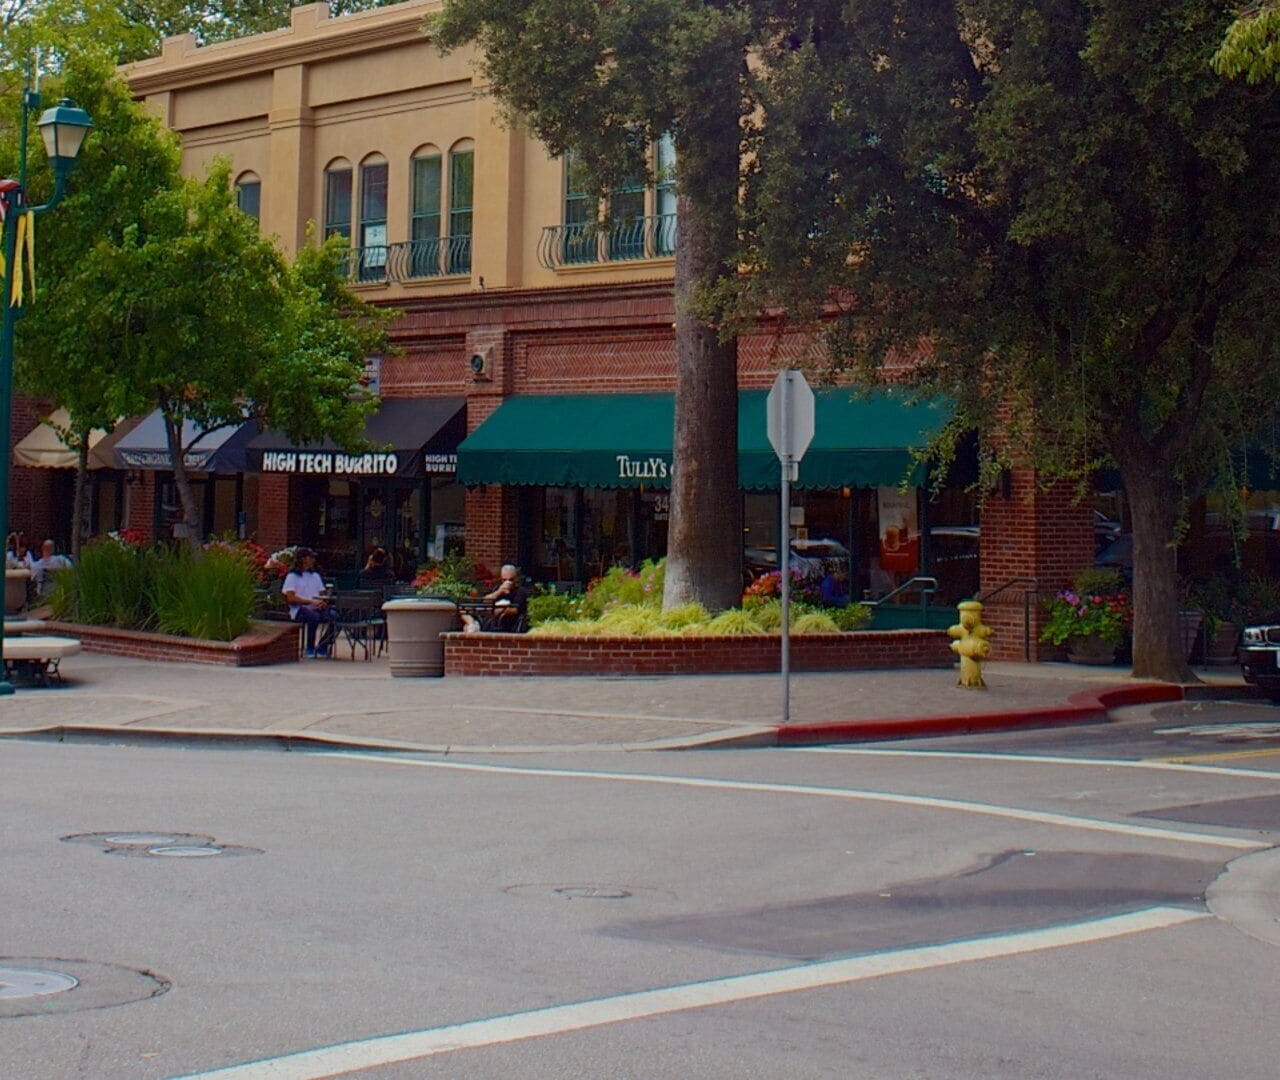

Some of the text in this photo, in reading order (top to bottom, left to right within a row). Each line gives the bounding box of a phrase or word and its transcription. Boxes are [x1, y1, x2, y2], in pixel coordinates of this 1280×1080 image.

[262, 452, 398, 474] HIGH TECH BURRITO
[425, 454, 448, 464] HIGH
